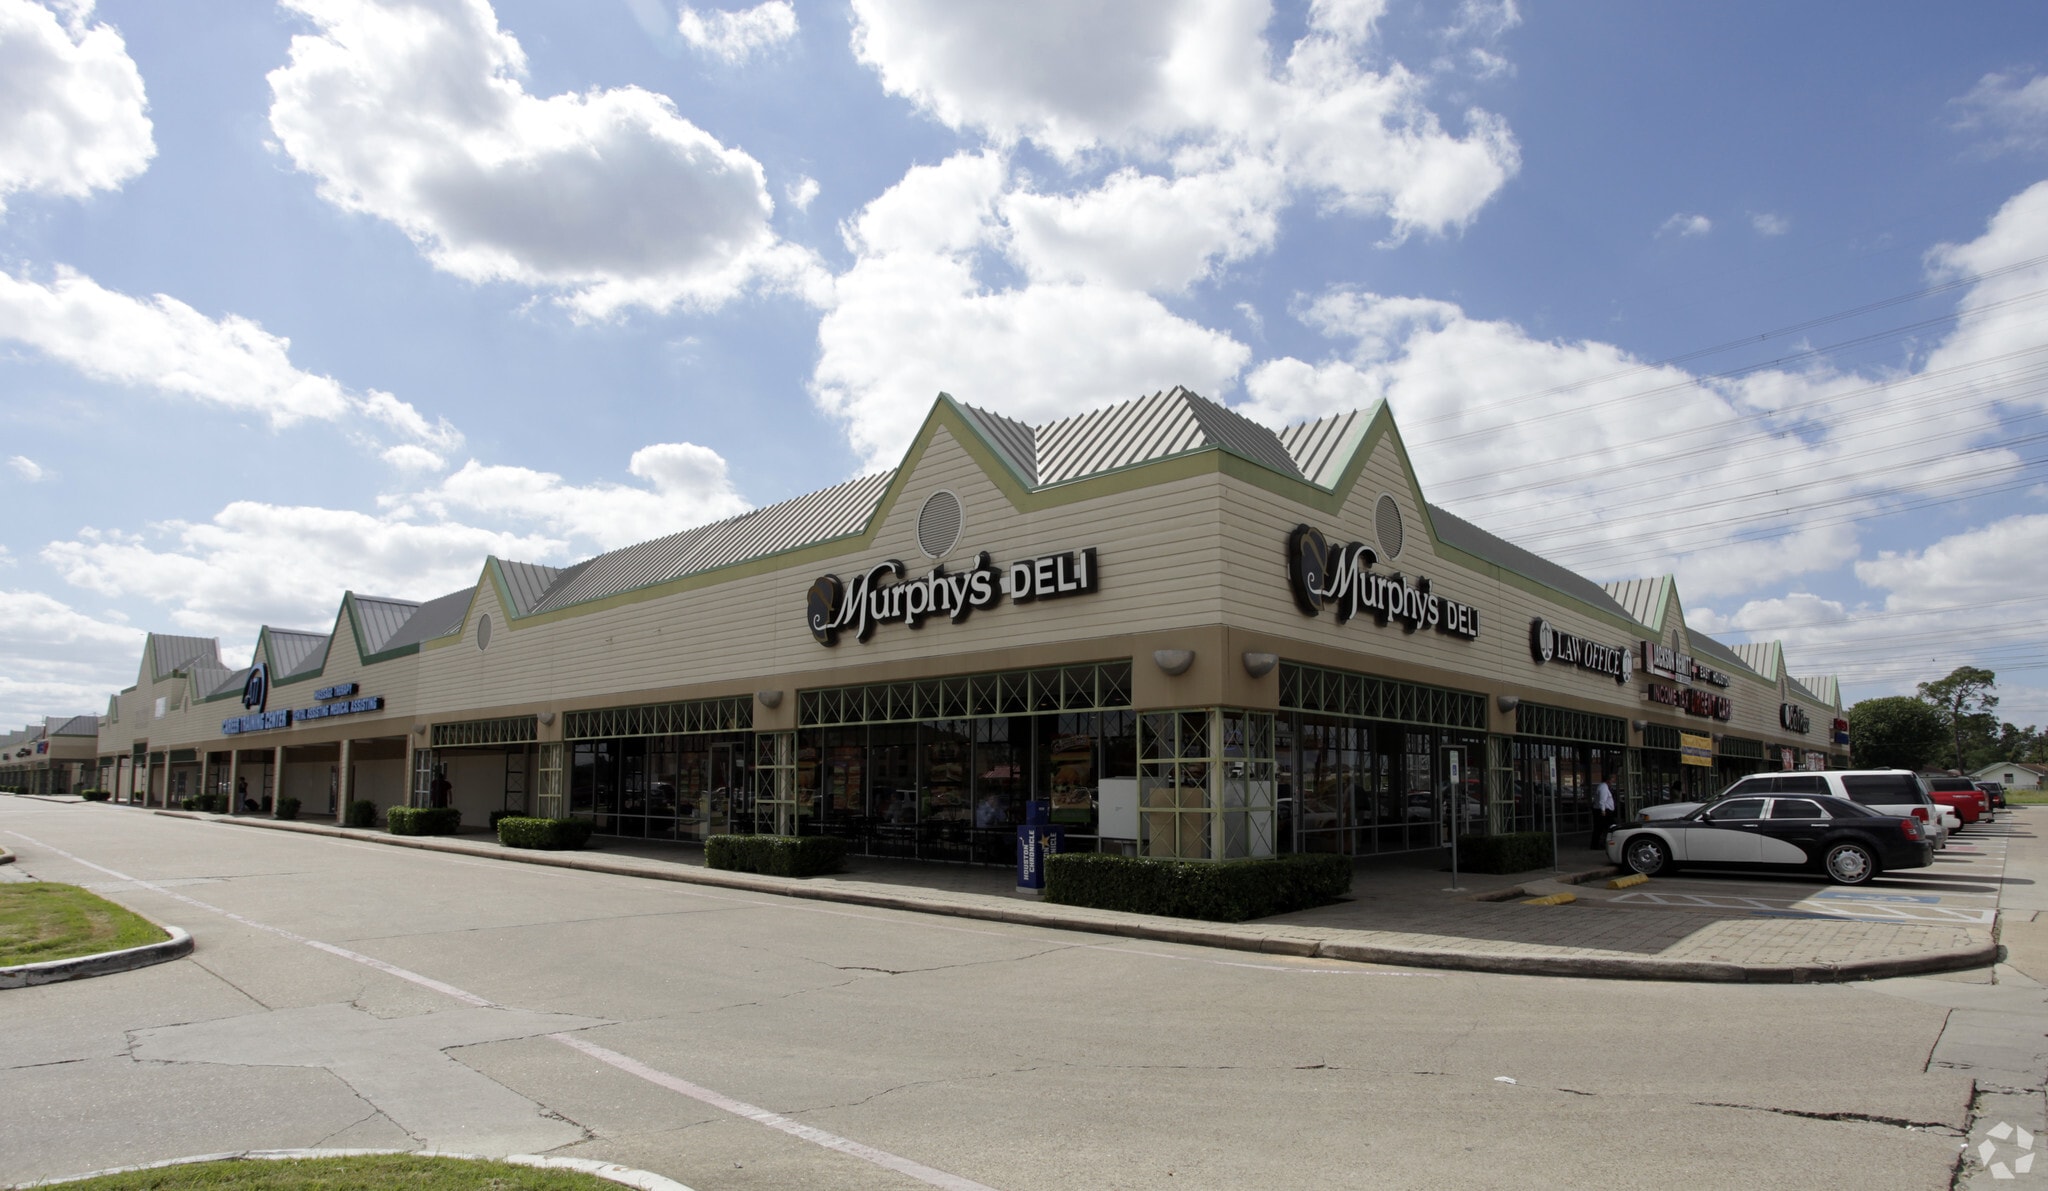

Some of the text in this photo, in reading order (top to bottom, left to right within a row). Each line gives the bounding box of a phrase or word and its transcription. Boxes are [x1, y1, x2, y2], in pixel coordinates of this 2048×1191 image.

[814, 552, 1088, 640] Murphy's DELI
[1309, 545, 1481, 637] Murphy's DELI
[1557, 632, 1621, 675] LAW OFFICE
[330, 700, 349, 717] MEDICAL
[350, 697, 378, 713] ASSISTING
[1654, 684, 1689, 708] INCOME TAX
[1692, 690, 1716, 716] URGENT
[265, 709, 287, 729] CENTER
